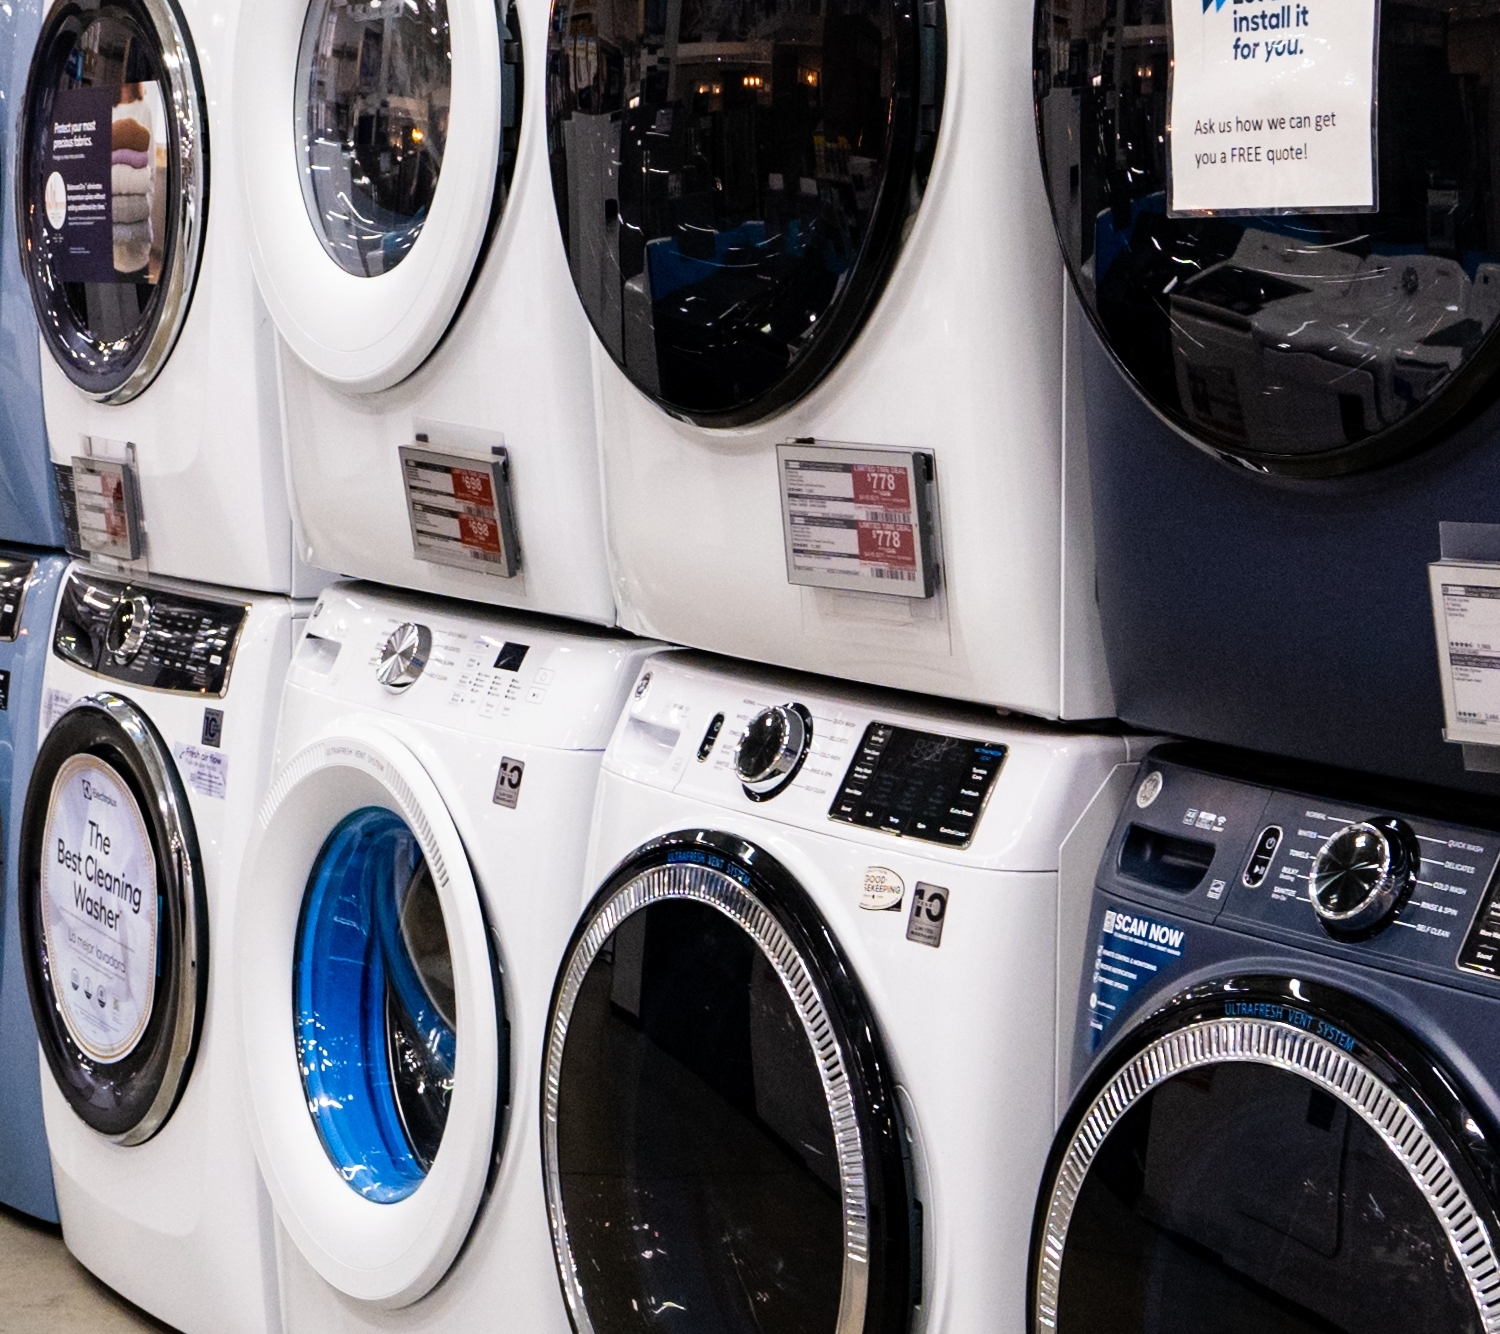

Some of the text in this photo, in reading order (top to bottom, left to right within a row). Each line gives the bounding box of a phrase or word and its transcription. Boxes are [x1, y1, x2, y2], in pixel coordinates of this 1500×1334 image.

[1233, 4, 1309, 34] install it
[1233, 36, 1305, 63] for you.
[54, 120, 96, 134] Protect your most
[1194, 110, 1337, 136] Ask us how we can get
[1195, 143, 1308, 169] you a FREE quote!
[867, 473, 895, 491] $778
[872, 530, 900, 548] $778
[185, 746, 201, 759] Fresh
[210, 753, 222, 764] flow
[501, 762, 523, 790] 10
[92, 788, 117, 807] Electrolux
[89, 820, 111, 855] The
[58, 838, 142, 915] Best Cleaning
[667, 851, 750, 885] ULTRAFRESH VENT SYSTEM
[74, 881, 120, 932] Washer
[914, 888, 947, 923] 10
[1420, 901, 1437, 912] RINSE
[1443, 907, 1458, 916] SPIN
[1115, 913, 1149, 939] SCAN
[1149, 925, 1184, 948] NOW
[77, 936, 94, 955] mejor
[95, 945, 126, 973] lavadora
[1224, 1002, 1356, 1052] ULTRAFRESH VENT SYSTEM
